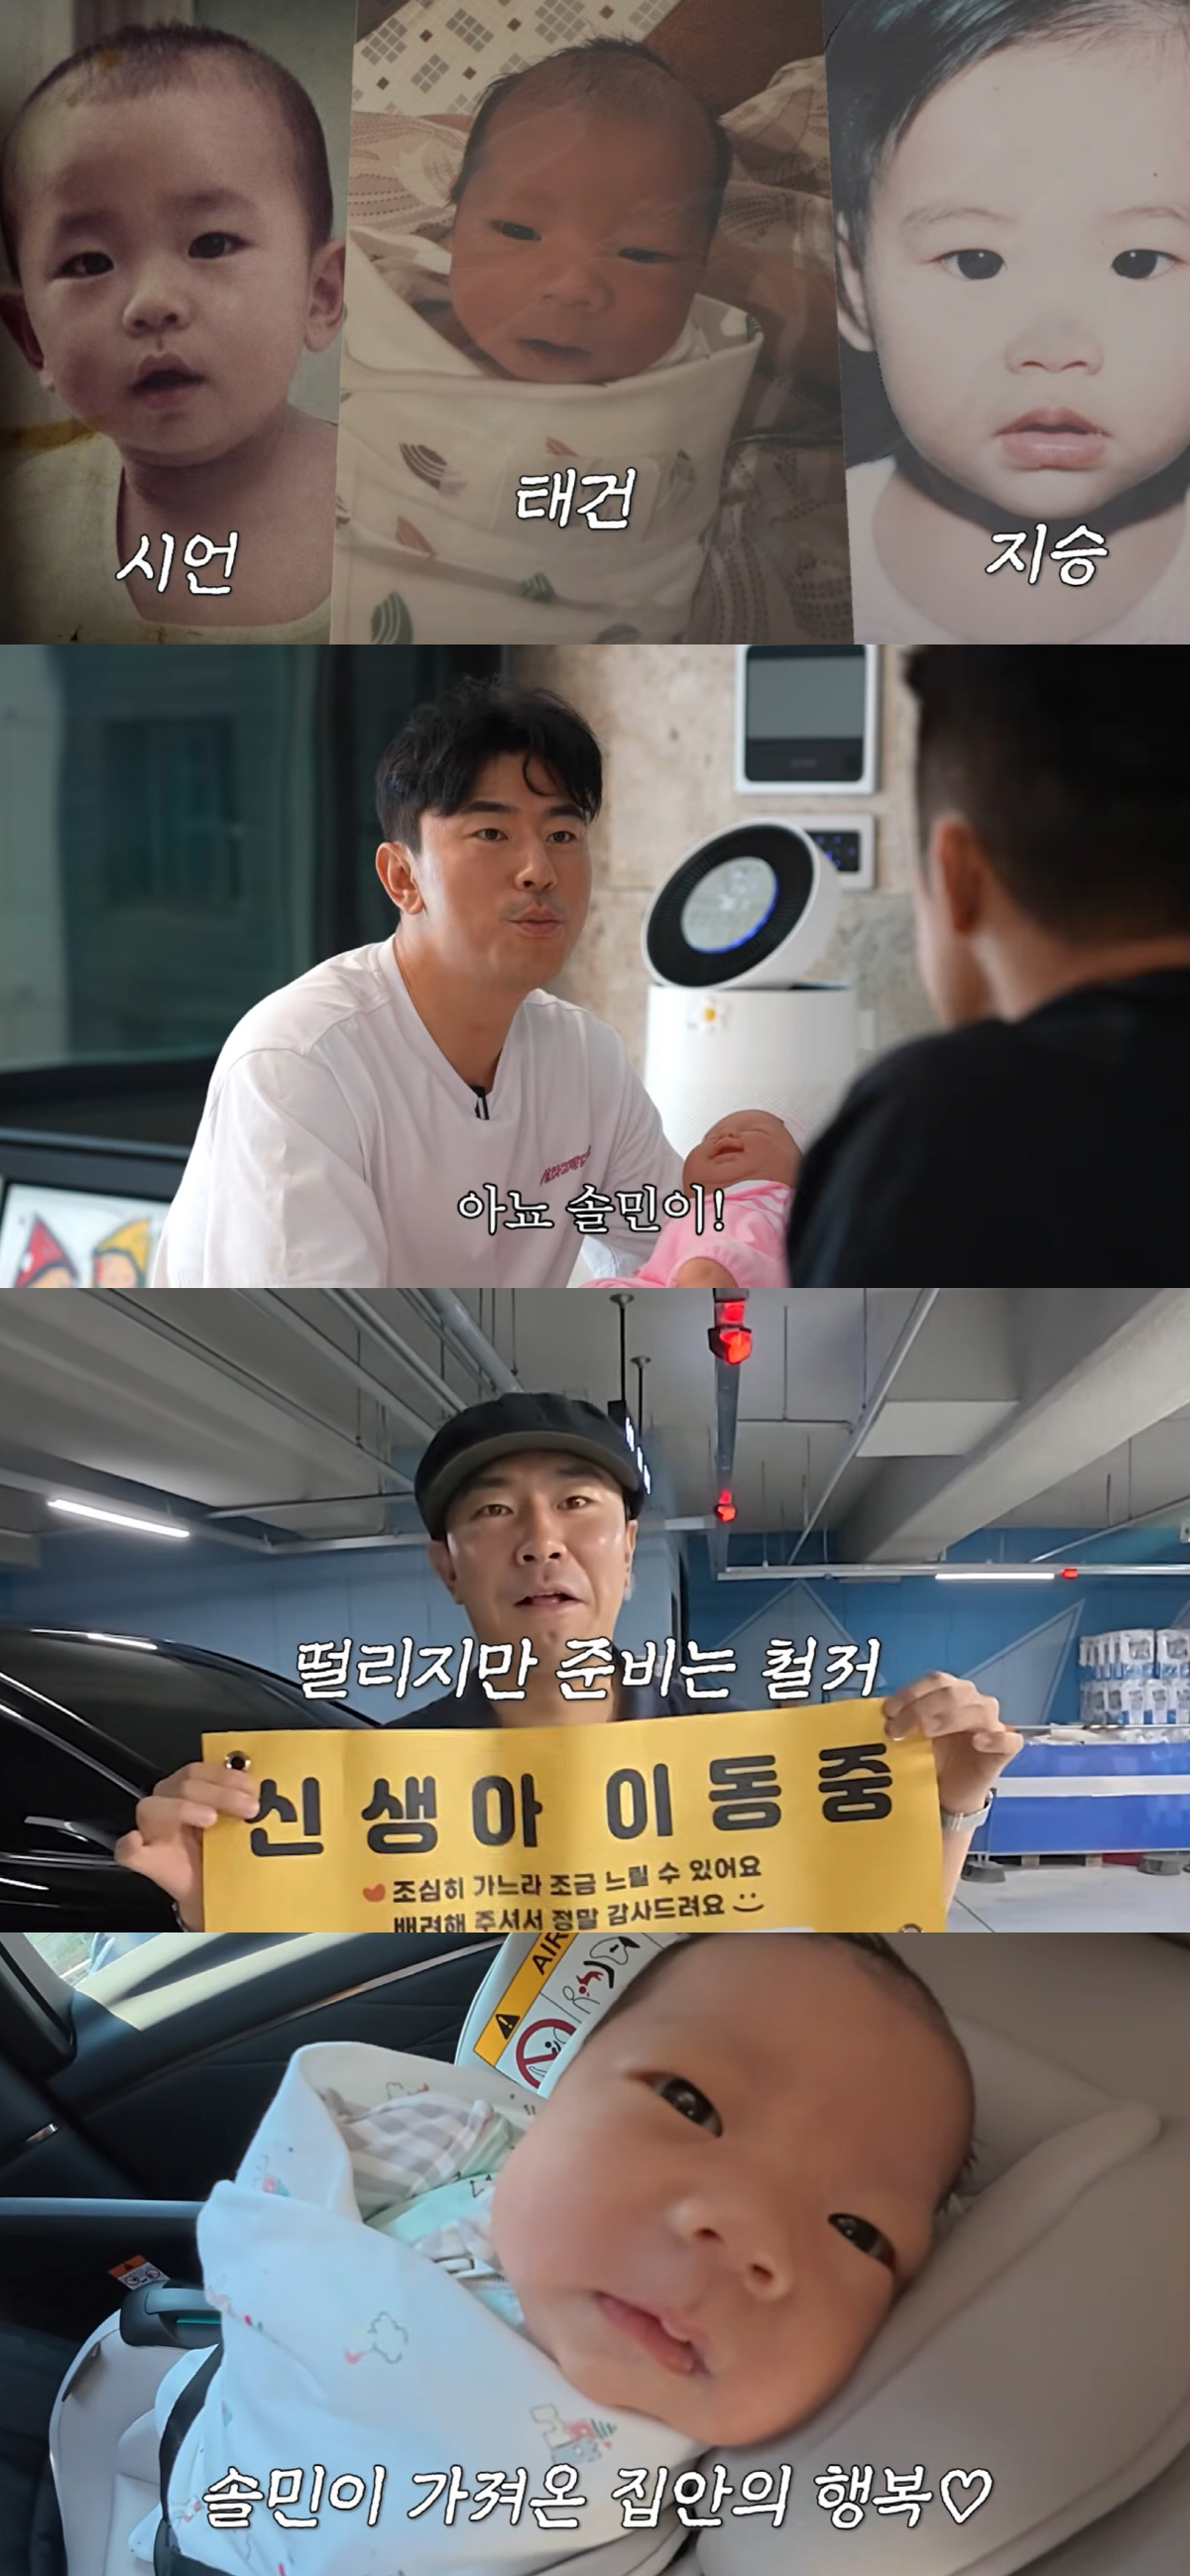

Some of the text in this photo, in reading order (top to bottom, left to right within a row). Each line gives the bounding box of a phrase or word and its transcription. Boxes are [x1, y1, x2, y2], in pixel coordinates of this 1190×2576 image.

[393, 1855, 762, 1904] 조심히 가느라 조금 느릴 수 있어요
[474, 1908, 543, 1932] 주셔서
[551, 1907, 599, 1932] 정말
[607, 1893, 725, 1927] 감사드려요
